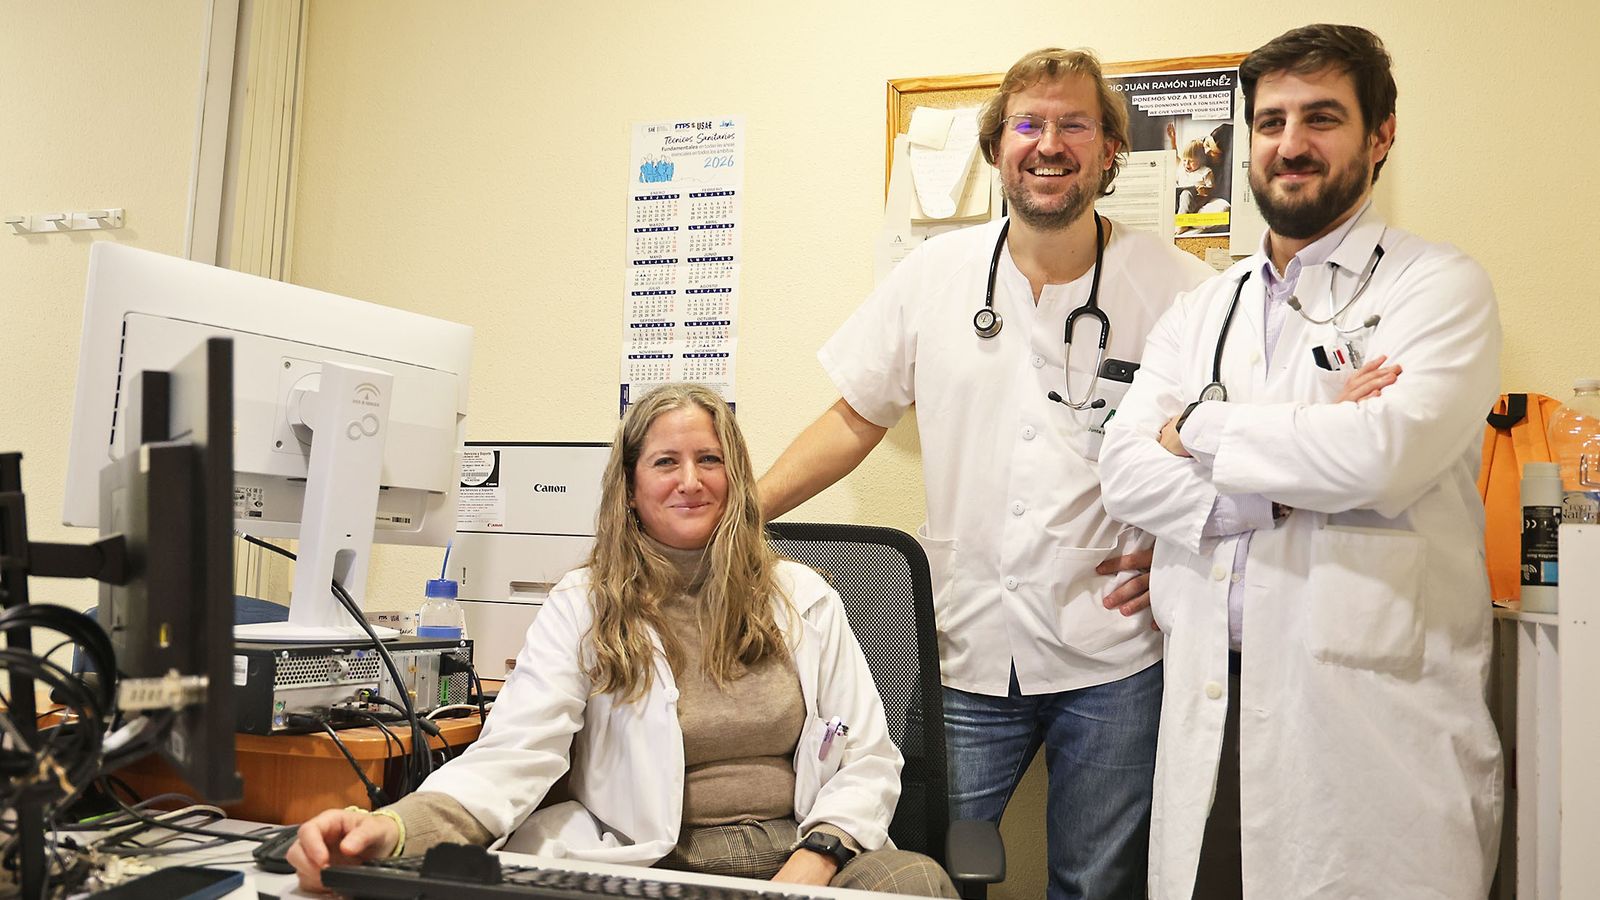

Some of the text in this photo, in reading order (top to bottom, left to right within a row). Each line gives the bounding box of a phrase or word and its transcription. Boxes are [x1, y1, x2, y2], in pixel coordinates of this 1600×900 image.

[1124, 82, 1150, 91] JUAN
[1152, 80, 1188, 89] RAMÓN
[1189, 76, 1231, 87] JIMÉNEZ
[696, 133, 735, 144] Sanitarios
[704, 155, 734, 168] 2026
[534, 484, 567, 492] Canon
